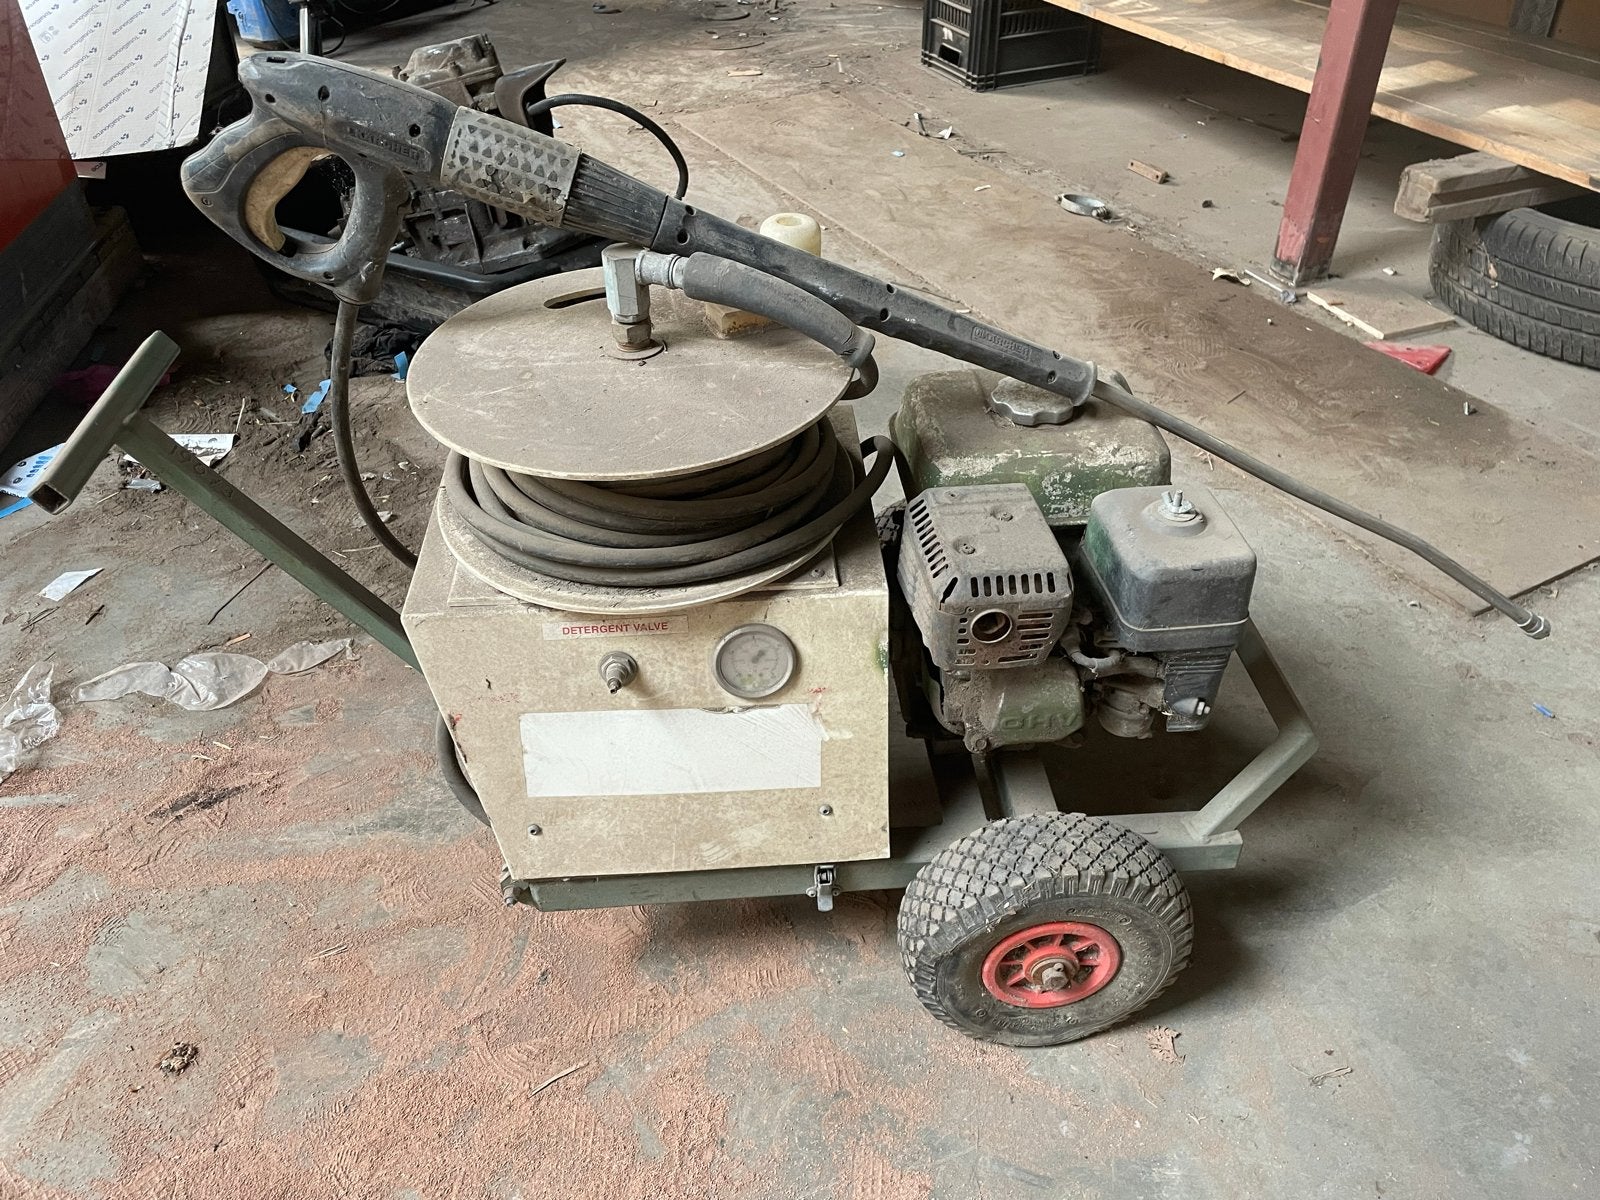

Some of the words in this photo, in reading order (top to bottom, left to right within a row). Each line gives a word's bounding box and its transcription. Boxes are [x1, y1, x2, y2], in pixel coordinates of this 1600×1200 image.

[562, 623, 630, 636] DETERGENT
[633, 621, 669, 633] VALVE
[1001, 711, 1080, 731] OHV
